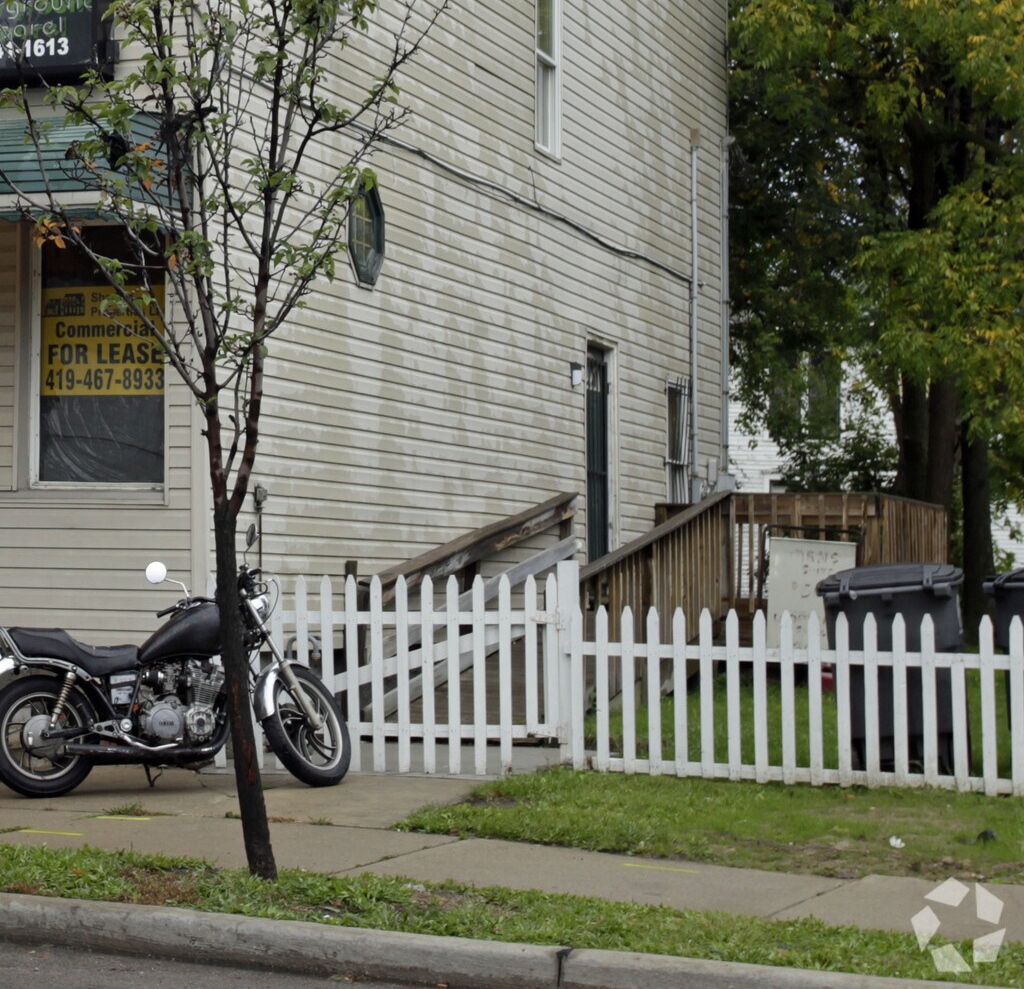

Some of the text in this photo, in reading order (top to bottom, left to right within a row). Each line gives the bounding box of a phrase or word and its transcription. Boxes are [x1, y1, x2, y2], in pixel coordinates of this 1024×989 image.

[55, 320, 156, 339] Commercial
[48, 342, 164, 365] FOR LEASE
[45, 367, 165, 391] 419-467-8933
